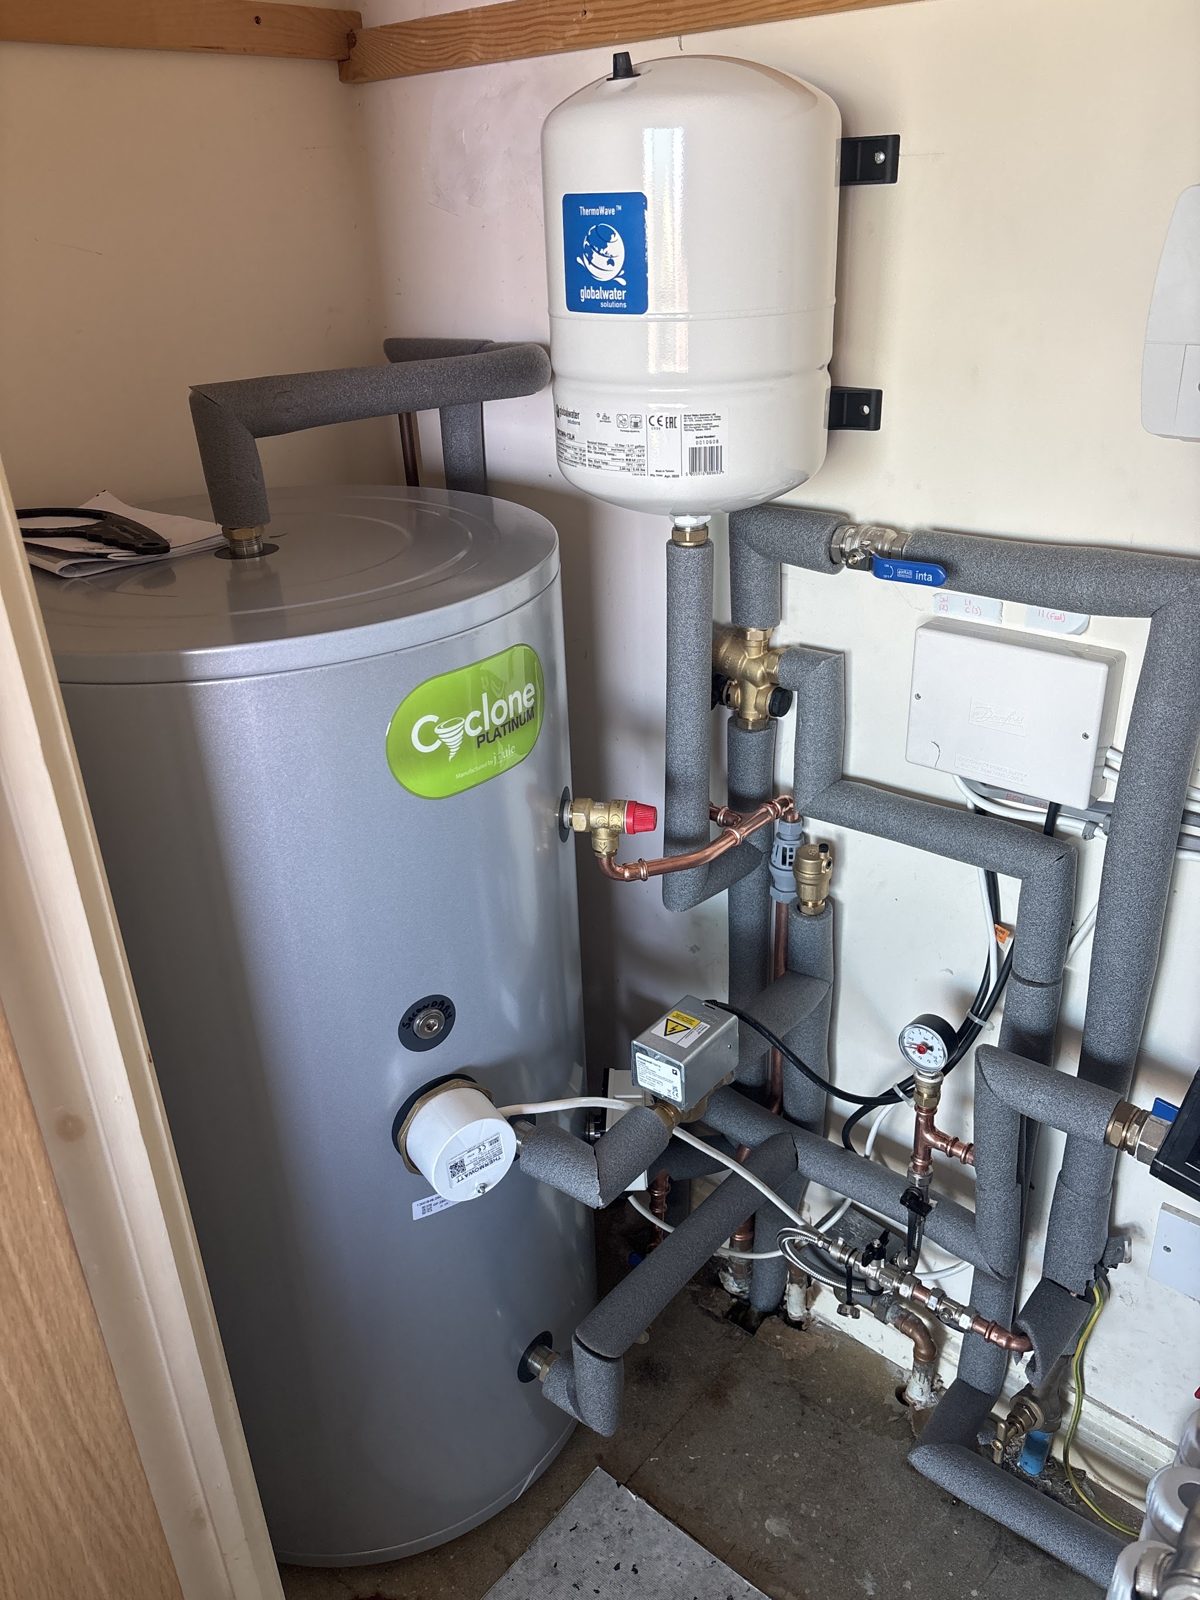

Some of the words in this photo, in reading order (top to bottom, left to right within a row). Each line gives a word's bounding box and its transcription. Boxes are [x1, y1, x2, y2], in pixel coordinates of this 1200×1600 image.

[579, 286, 627, 303] globalwater
[600, 301, 627, 309] solutions
[915, 570, 933, 582] inta
[476, 706, 535, 749] PLATINUM
[456, 1156, 502, 1184] THERMOWATT
